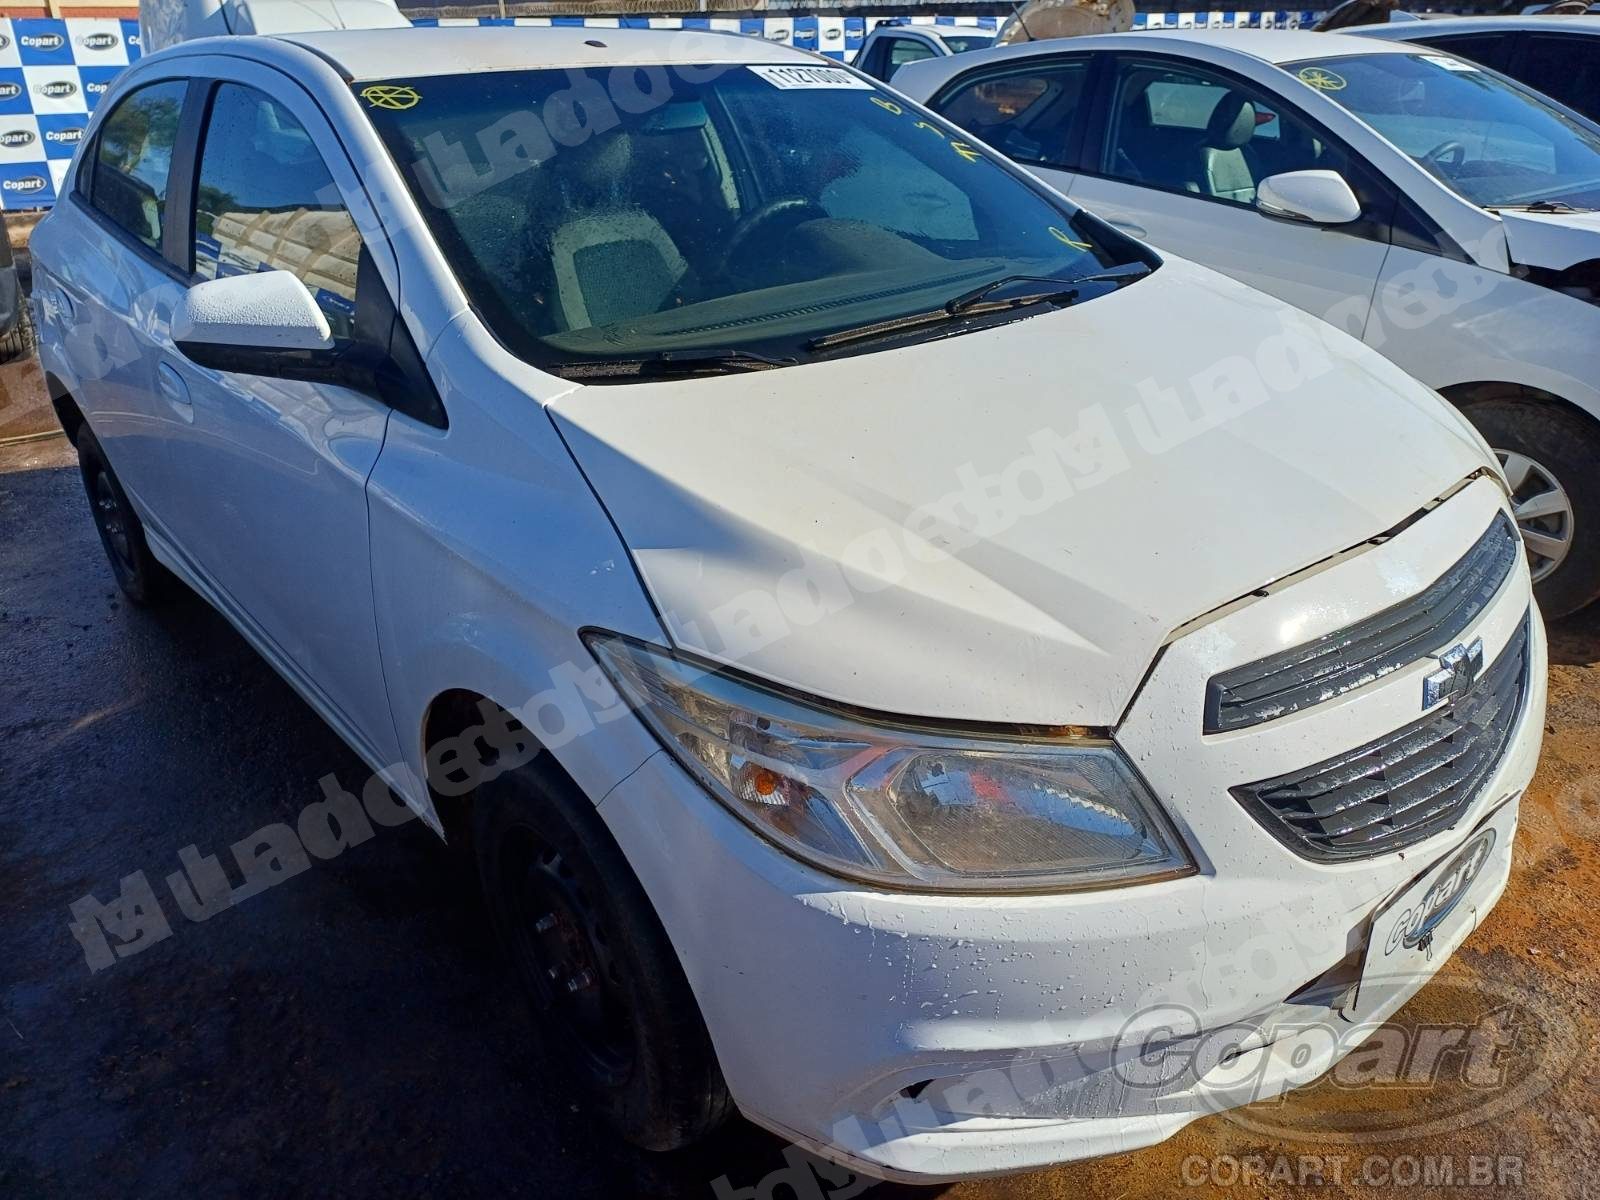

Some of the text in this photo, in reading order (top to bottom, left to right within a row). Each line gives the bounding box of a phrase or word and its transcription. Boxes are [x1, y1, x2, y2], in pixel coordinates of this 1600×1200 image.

[21, 35, 59, 48] Copart
[87, 82, 108, 94] Cop
[0, 132, 29, 145] opart
[46, 129, 83, 142] Copart
[3, 178, 42, 191] Copart
[1384, 837, 1489, 957] Copart
